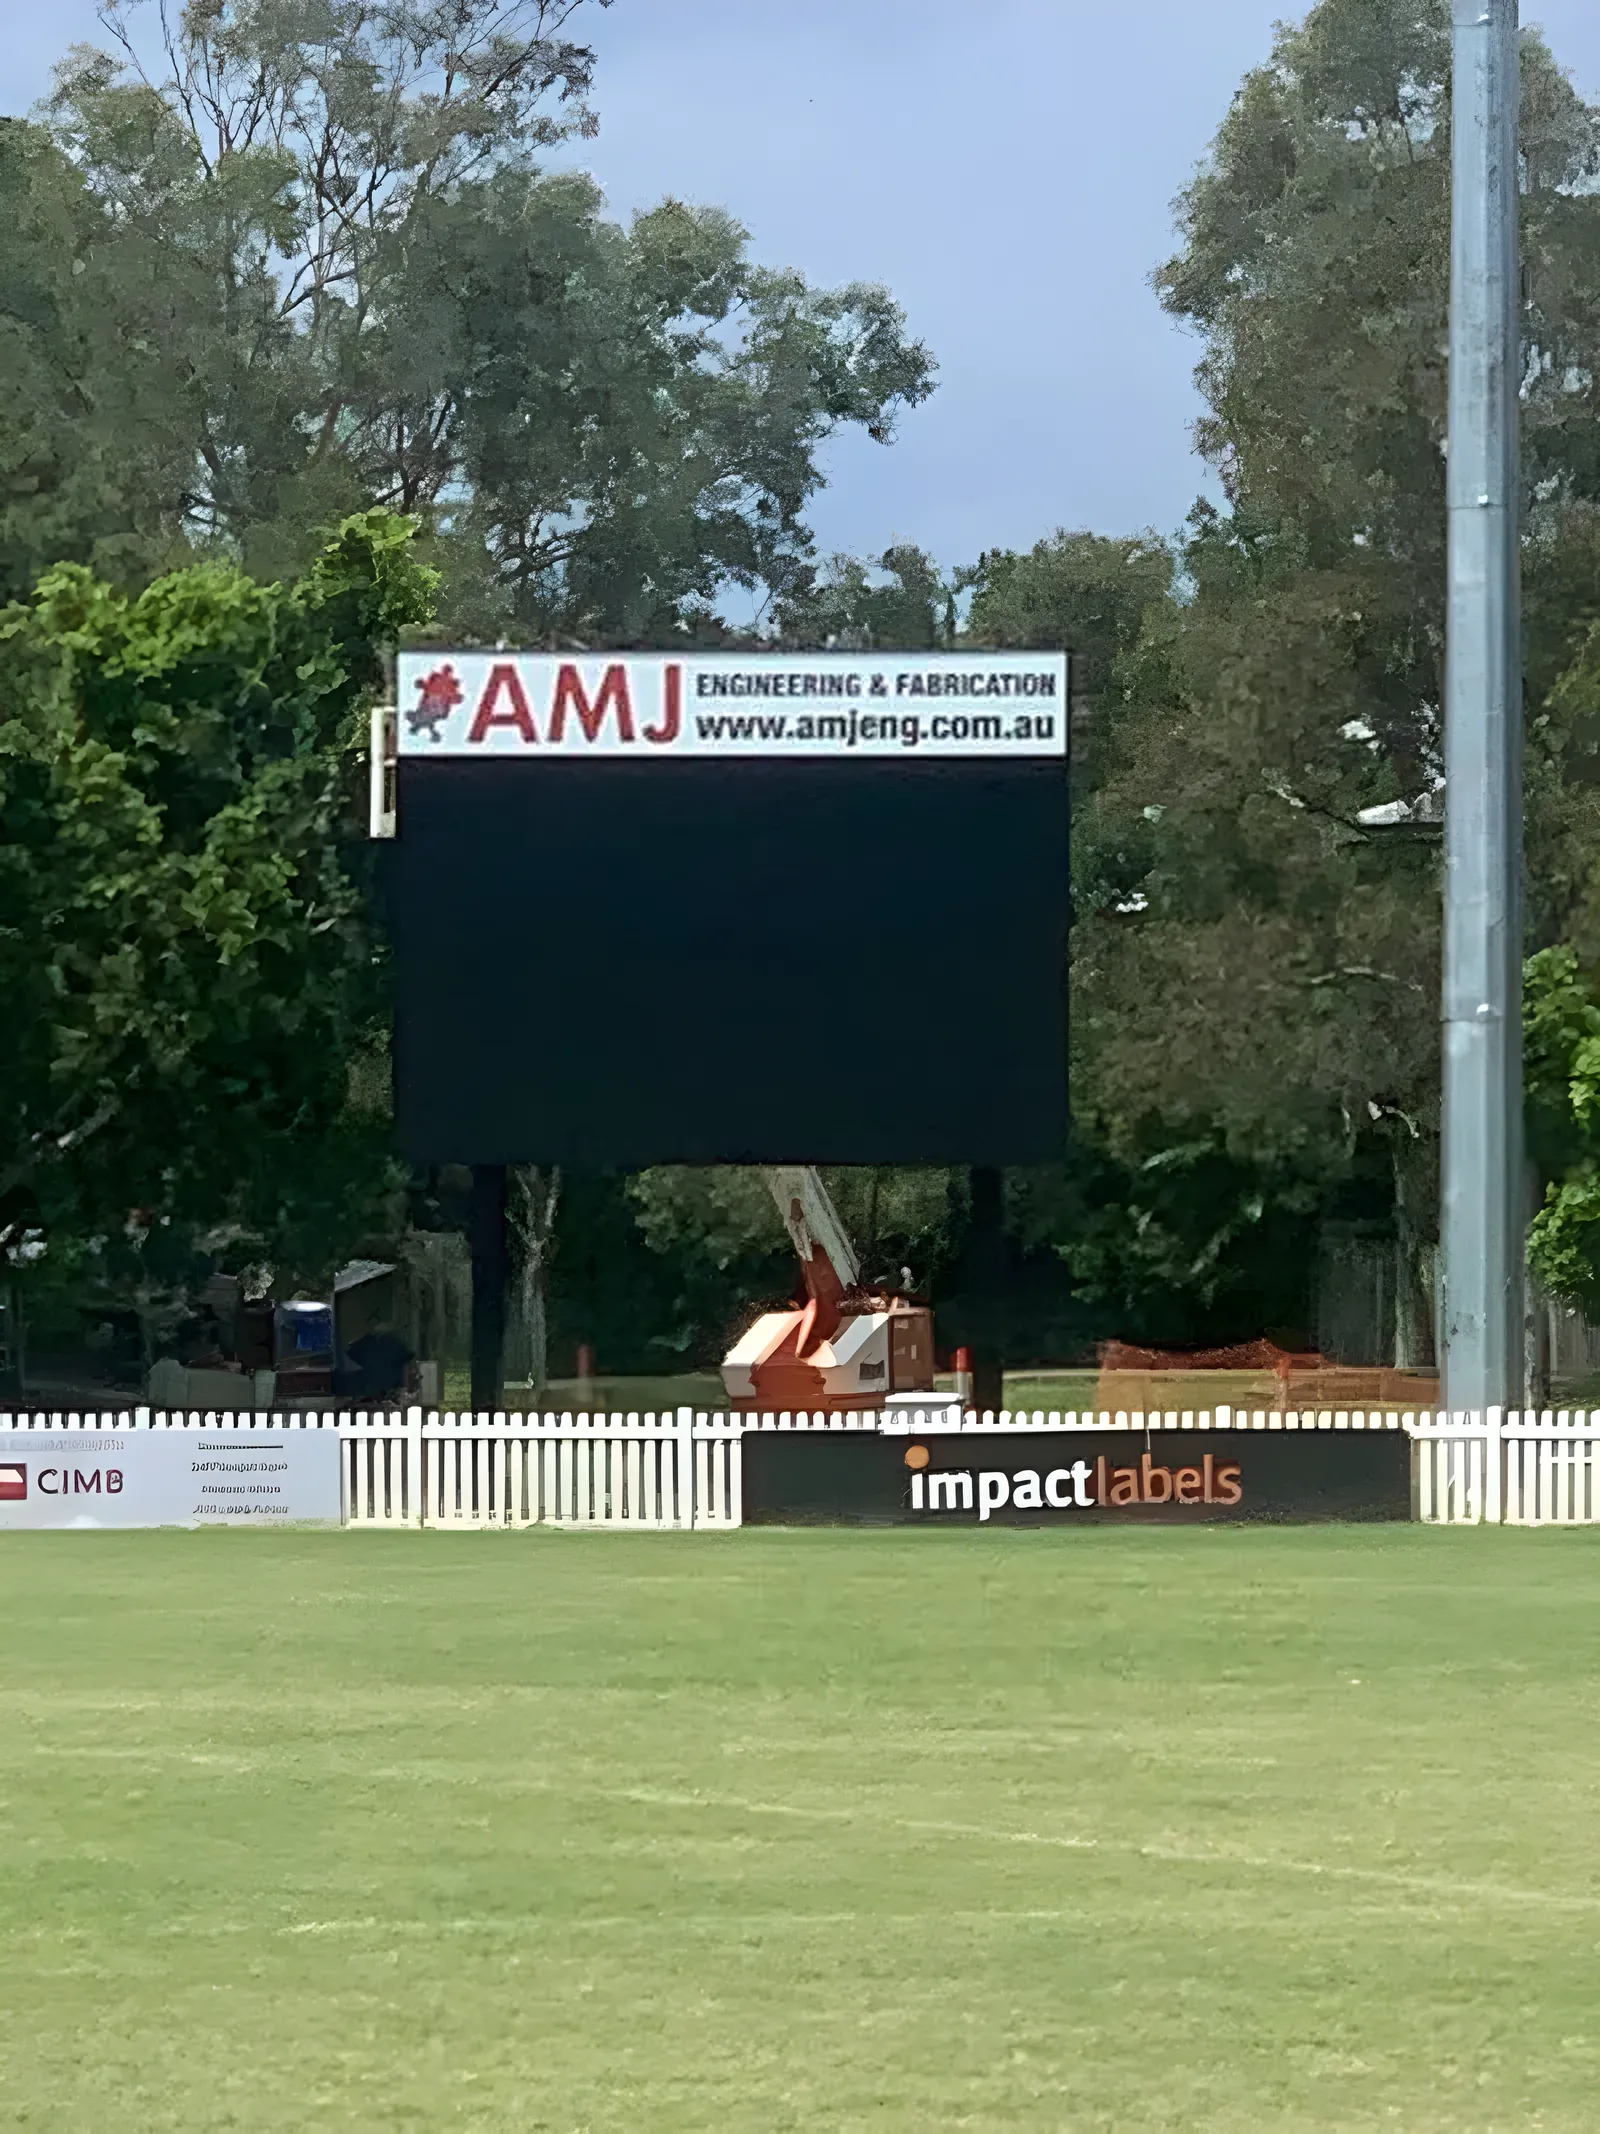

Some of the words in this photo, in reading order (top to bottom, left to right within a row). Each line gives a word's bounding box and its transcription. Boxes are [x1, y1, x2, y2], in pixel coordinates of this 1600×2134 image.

[697, 674, 862, 697] ENGINEERING
[869, 674, 887, 697] &
[896, 674, 1056, 696] FABRICATION
[469, 664, 681, 743] AMJ
[697, 709, 1054, 746] www.amjeng.com.au
[38, 1468, 124, 1495] CIMB
